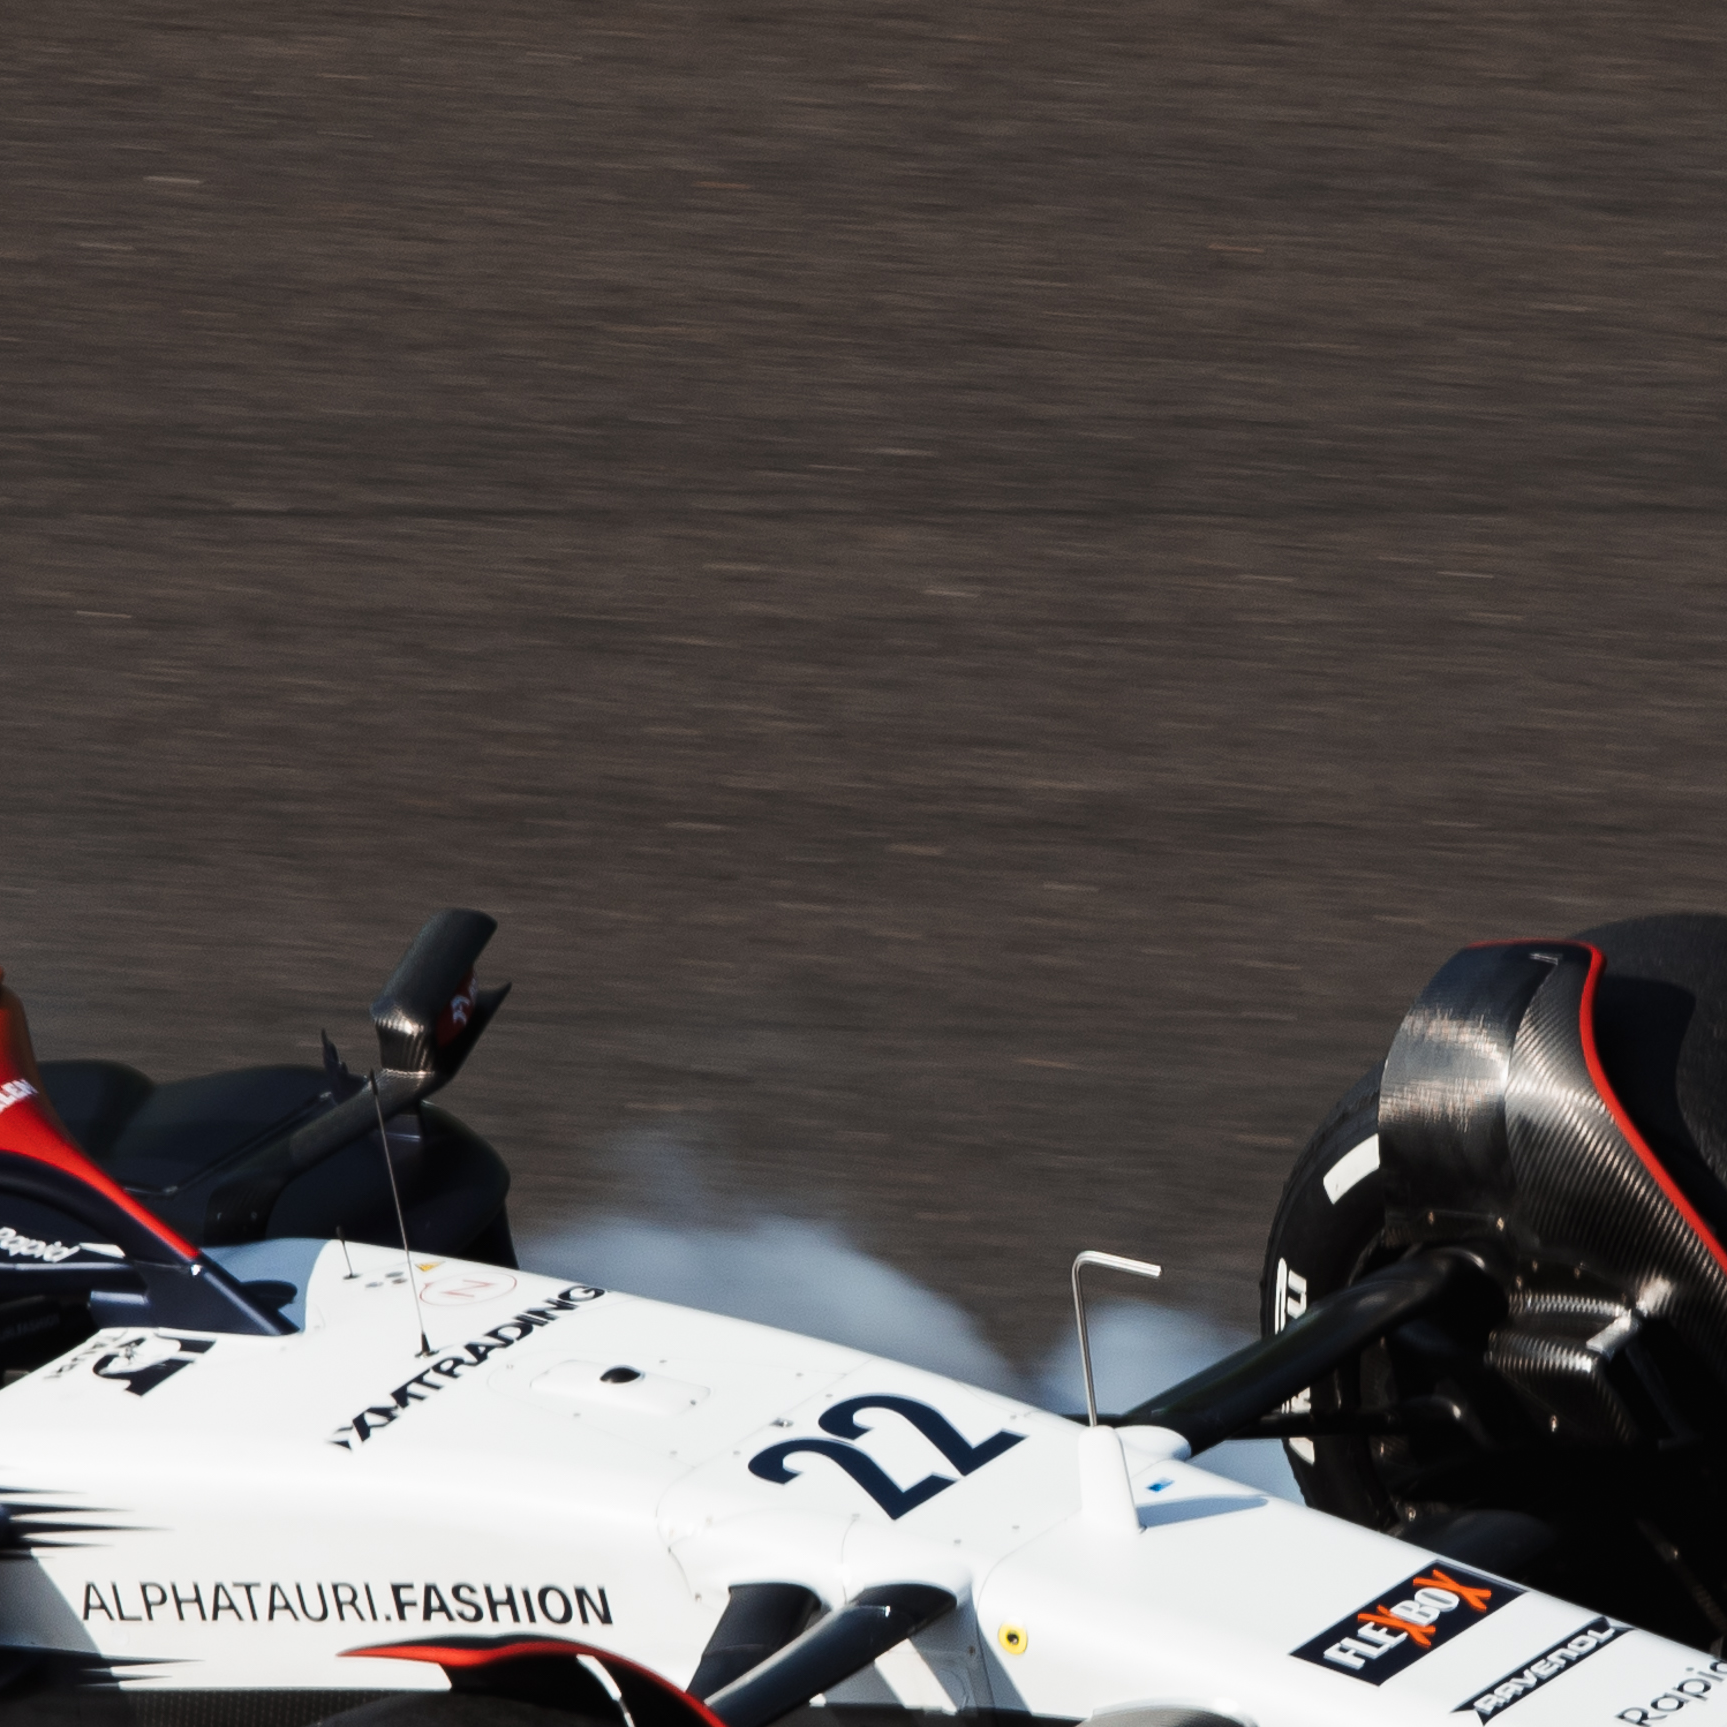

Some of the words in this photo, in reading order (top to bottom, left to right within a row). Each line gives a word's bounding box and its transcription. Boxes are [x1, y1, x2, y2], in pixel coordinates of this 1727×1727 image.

[747, 1392, 1029, 1521] 22
[82, 1580, 613, 1627] ALPHATAURI.FASHION
[1322, 1569, 1492, 1671] FLEXBOX
[1472, 1622, 1617, 1717] RAVENOL
